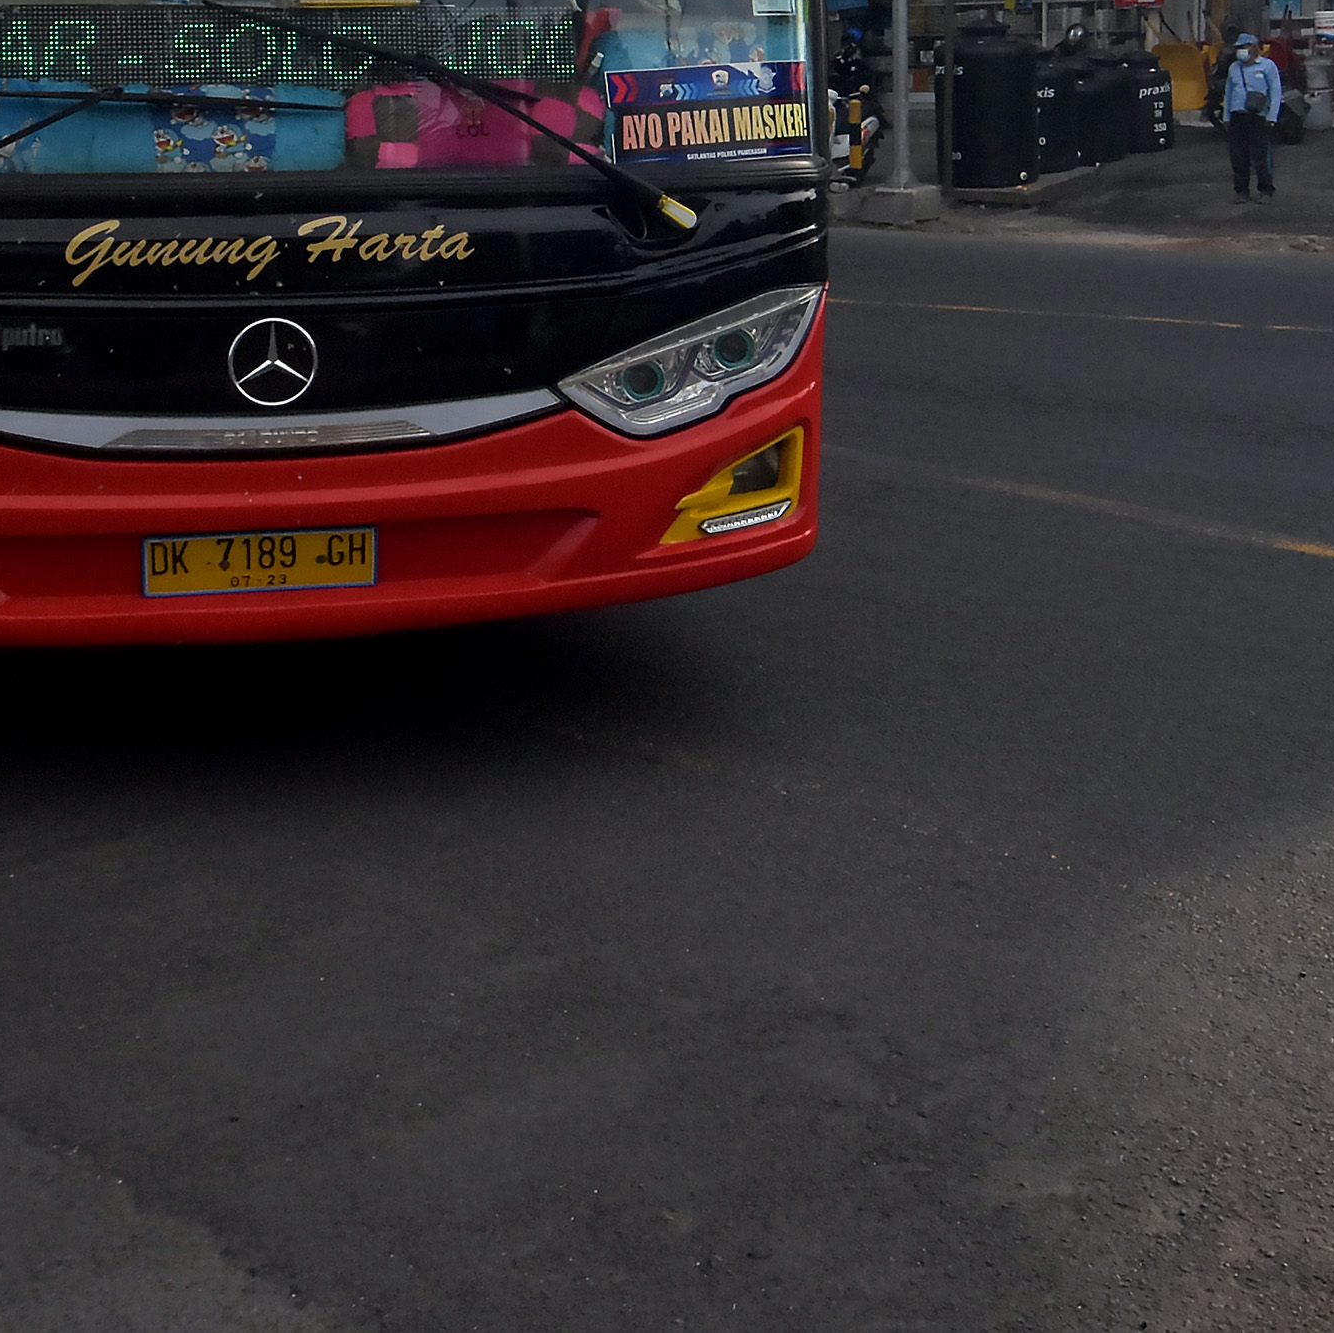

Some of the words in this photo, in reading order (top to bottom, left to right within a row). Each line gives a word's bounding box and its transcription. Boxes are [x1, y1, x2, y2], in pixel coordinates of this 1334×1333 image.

[166, 22, 375, 81] SOLO
[1138, 82, 1171, 100] praxis
[623, 112, 663, 150] AYO
[668, 108, 729, 147] PAKAI
[733, 103, 808, 141] MASKER!
[65, 219, 281, 286] Gunung
[296, 216, 475, 263] Harta
[151, 541, 188, 575] DK
[217, 536, 296, 569] 7189
[328, 534, 365, 565] GH
